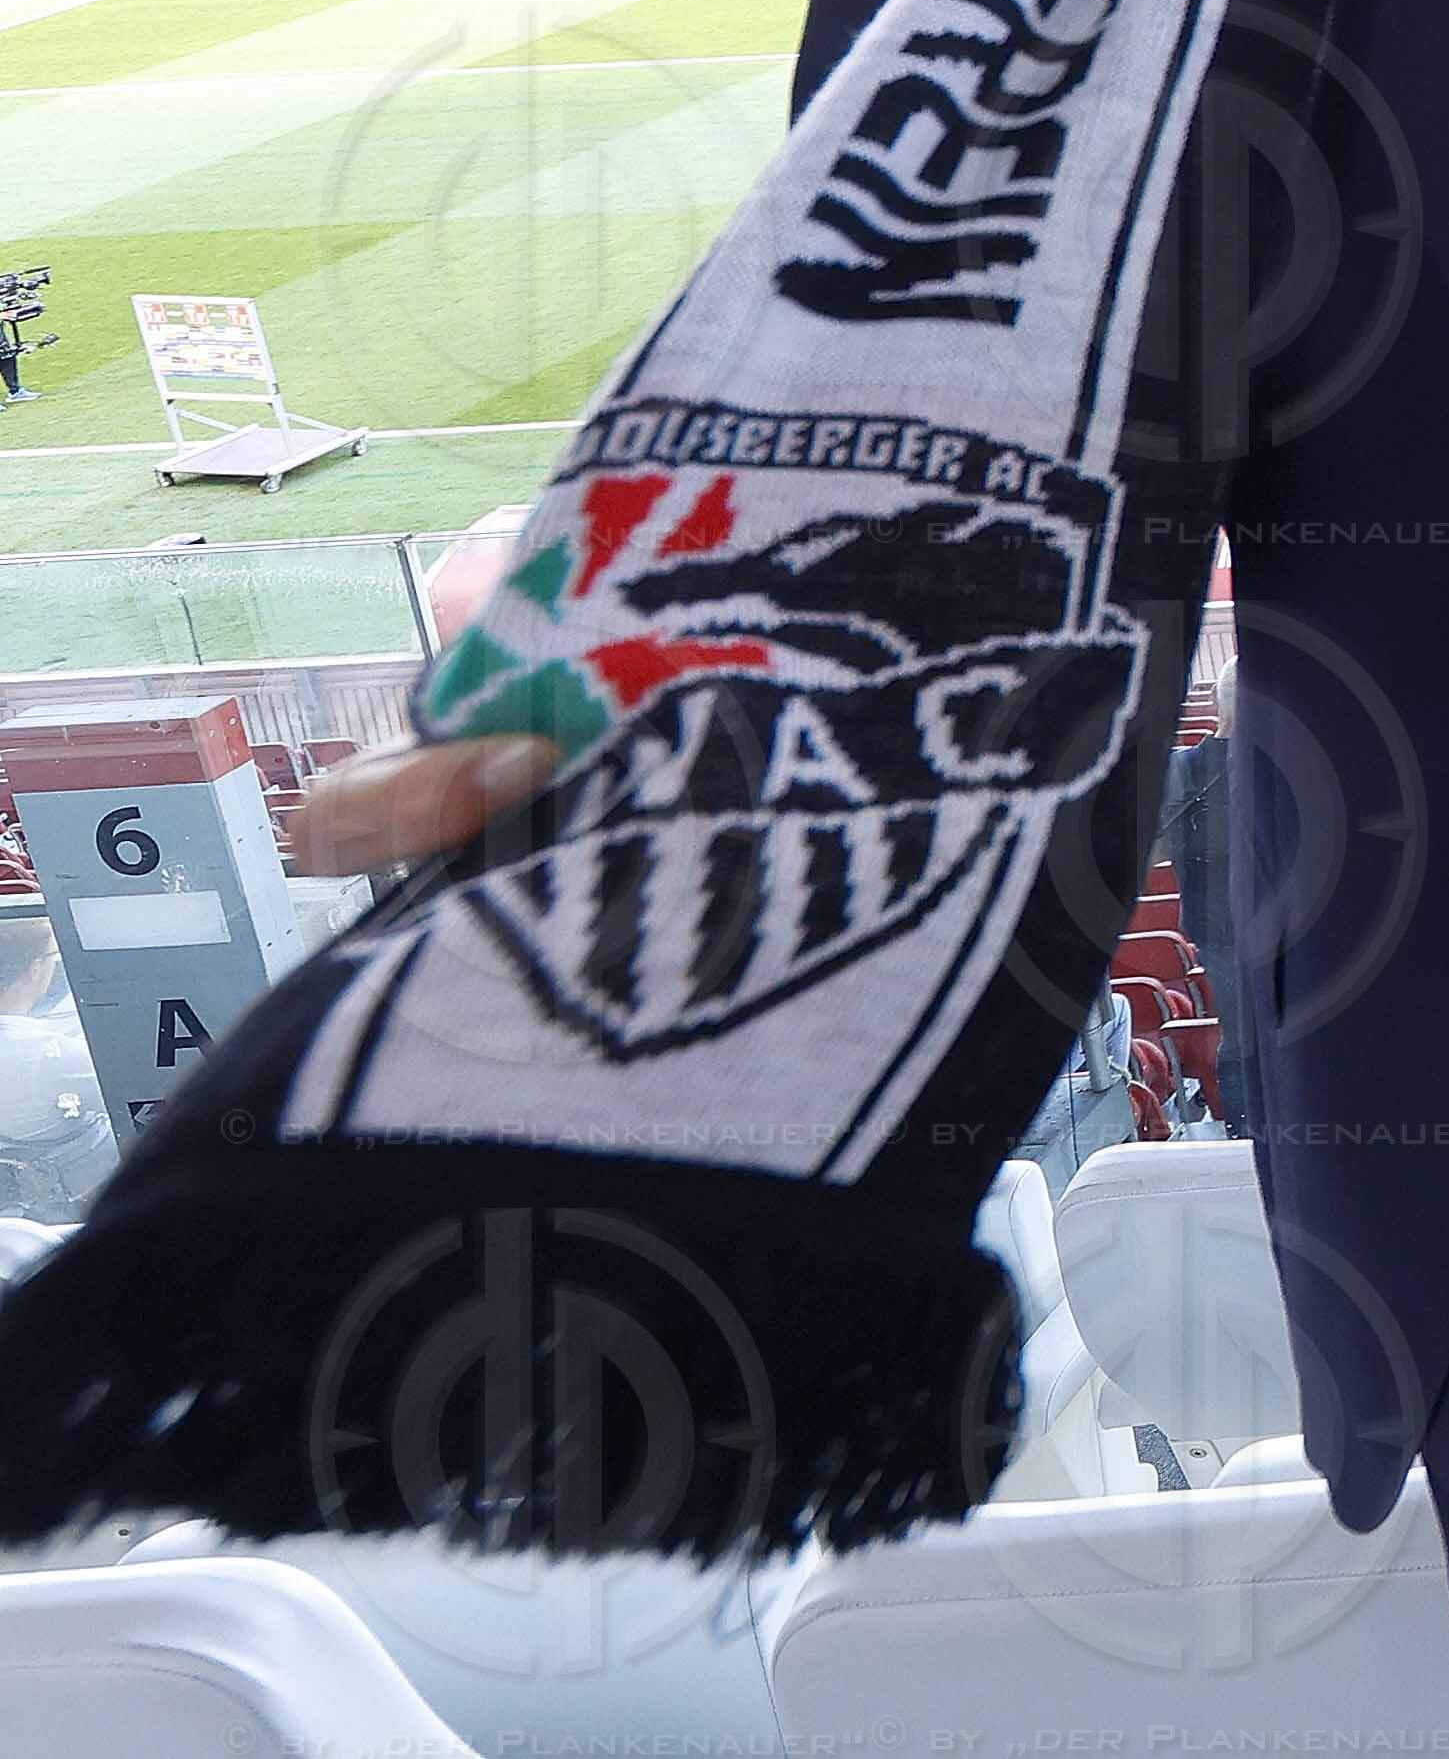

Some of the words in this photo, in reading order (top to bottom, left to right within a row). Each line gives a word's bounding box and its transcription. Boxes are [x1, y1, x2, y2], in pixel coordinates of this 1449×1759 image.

[563, 666, 1035, 841] WAC
[96, 806, 161, 877] 6
[156, 998, 215, 1068] A
